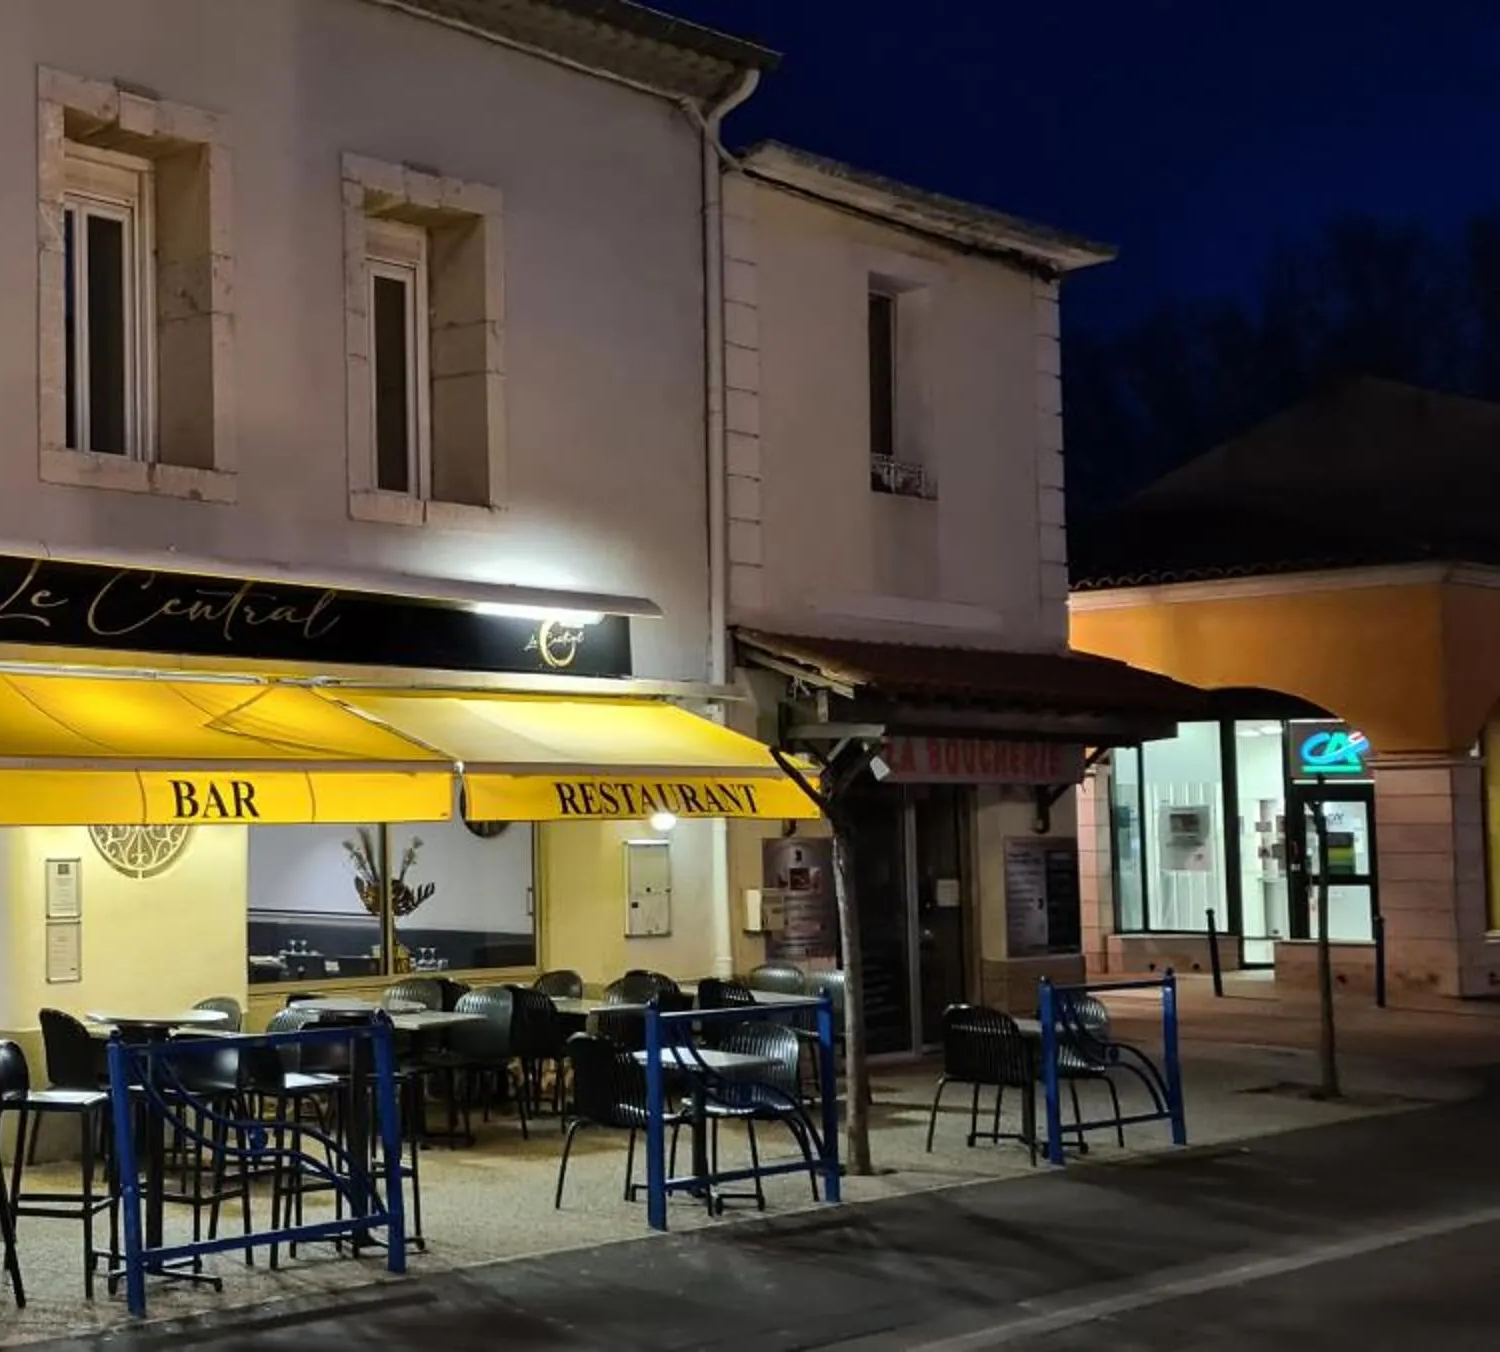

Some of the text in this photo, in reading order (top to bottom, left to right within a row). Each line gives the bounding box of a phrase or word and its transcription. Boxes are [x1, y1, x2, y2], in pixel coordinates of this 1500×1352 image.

[87, 568, 341, 641] Central
[168, 779, 261, 819] BAR
[554, 782, 760, 816] RESTAURANT
